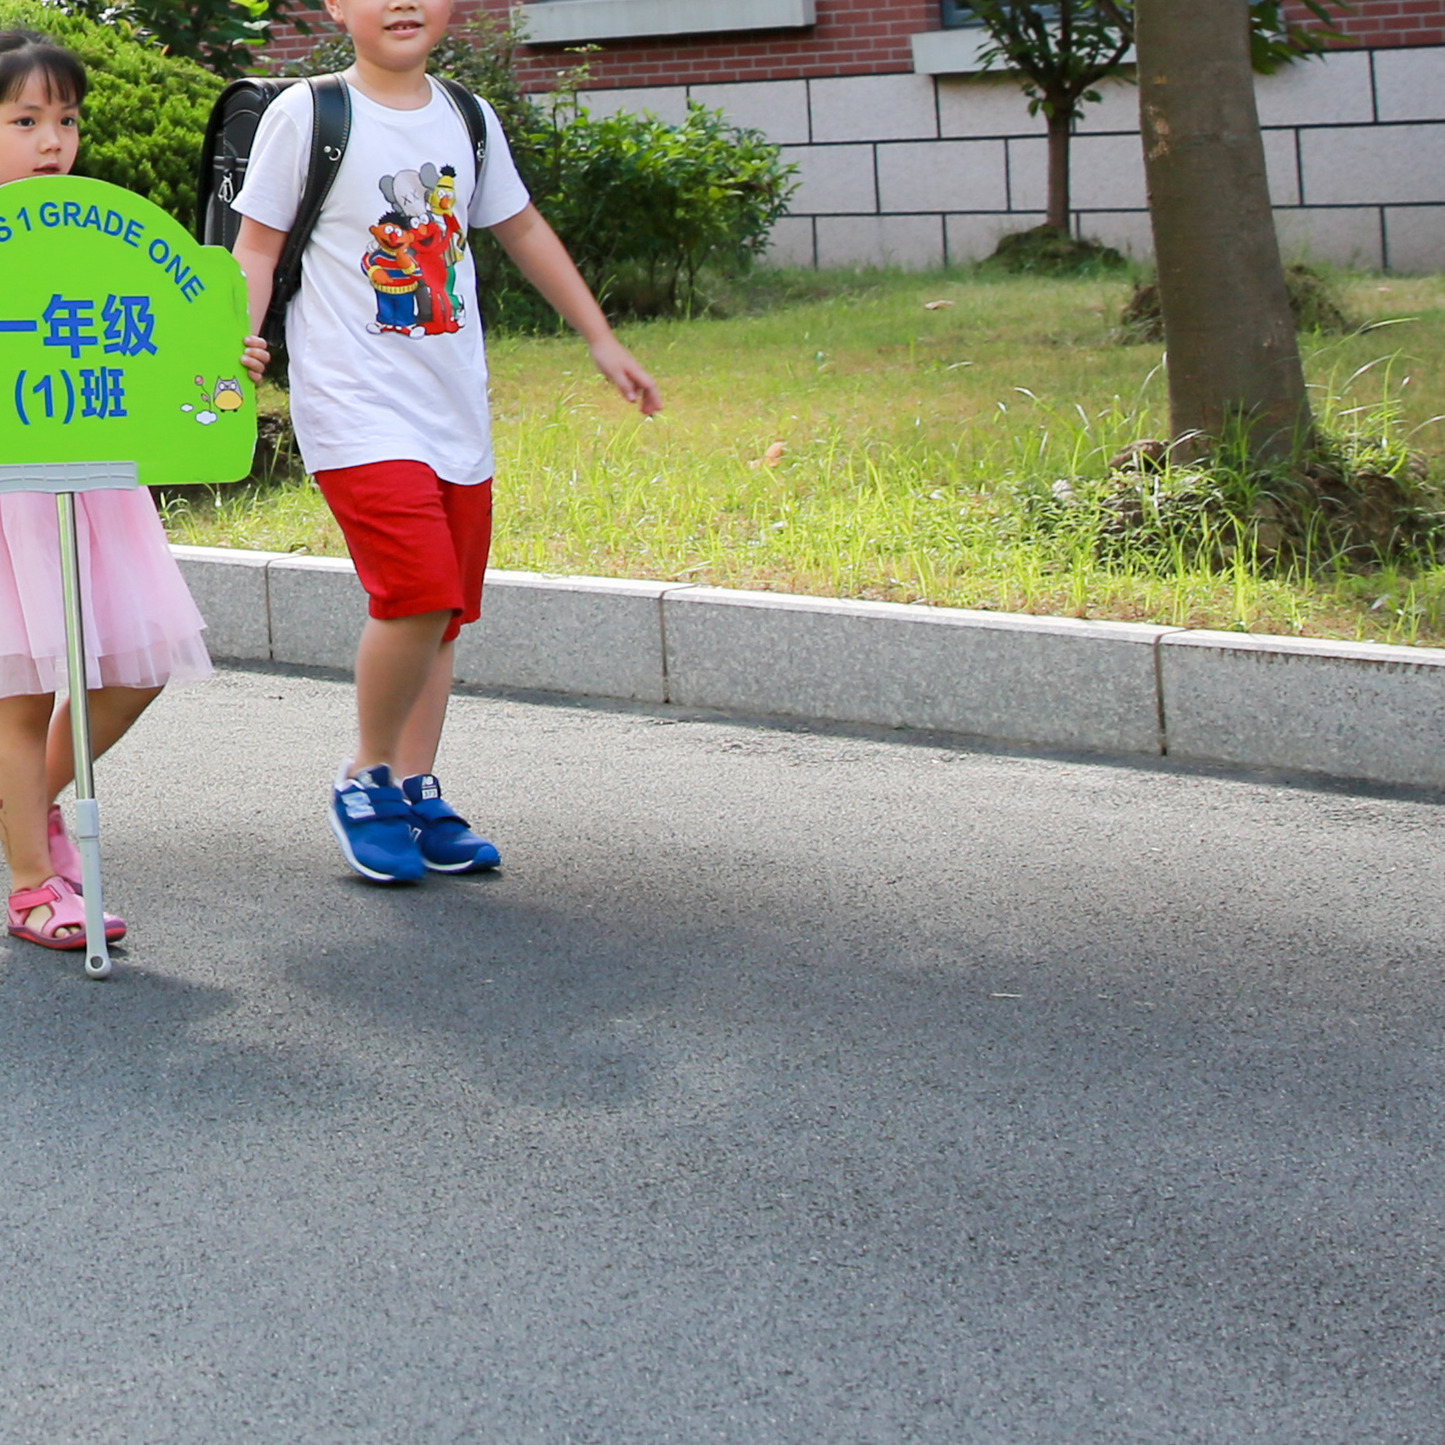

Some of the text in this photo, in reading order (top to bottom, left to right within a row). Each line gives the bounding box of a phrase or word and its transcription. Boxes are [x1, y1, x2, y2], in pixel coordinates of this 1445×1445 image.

[17, 206, 32, 232] 1
[39, 201, 145, 248] GRADE
[148, 238, 206, 303] ONE
[15, 366, 128, 426] (1)班
